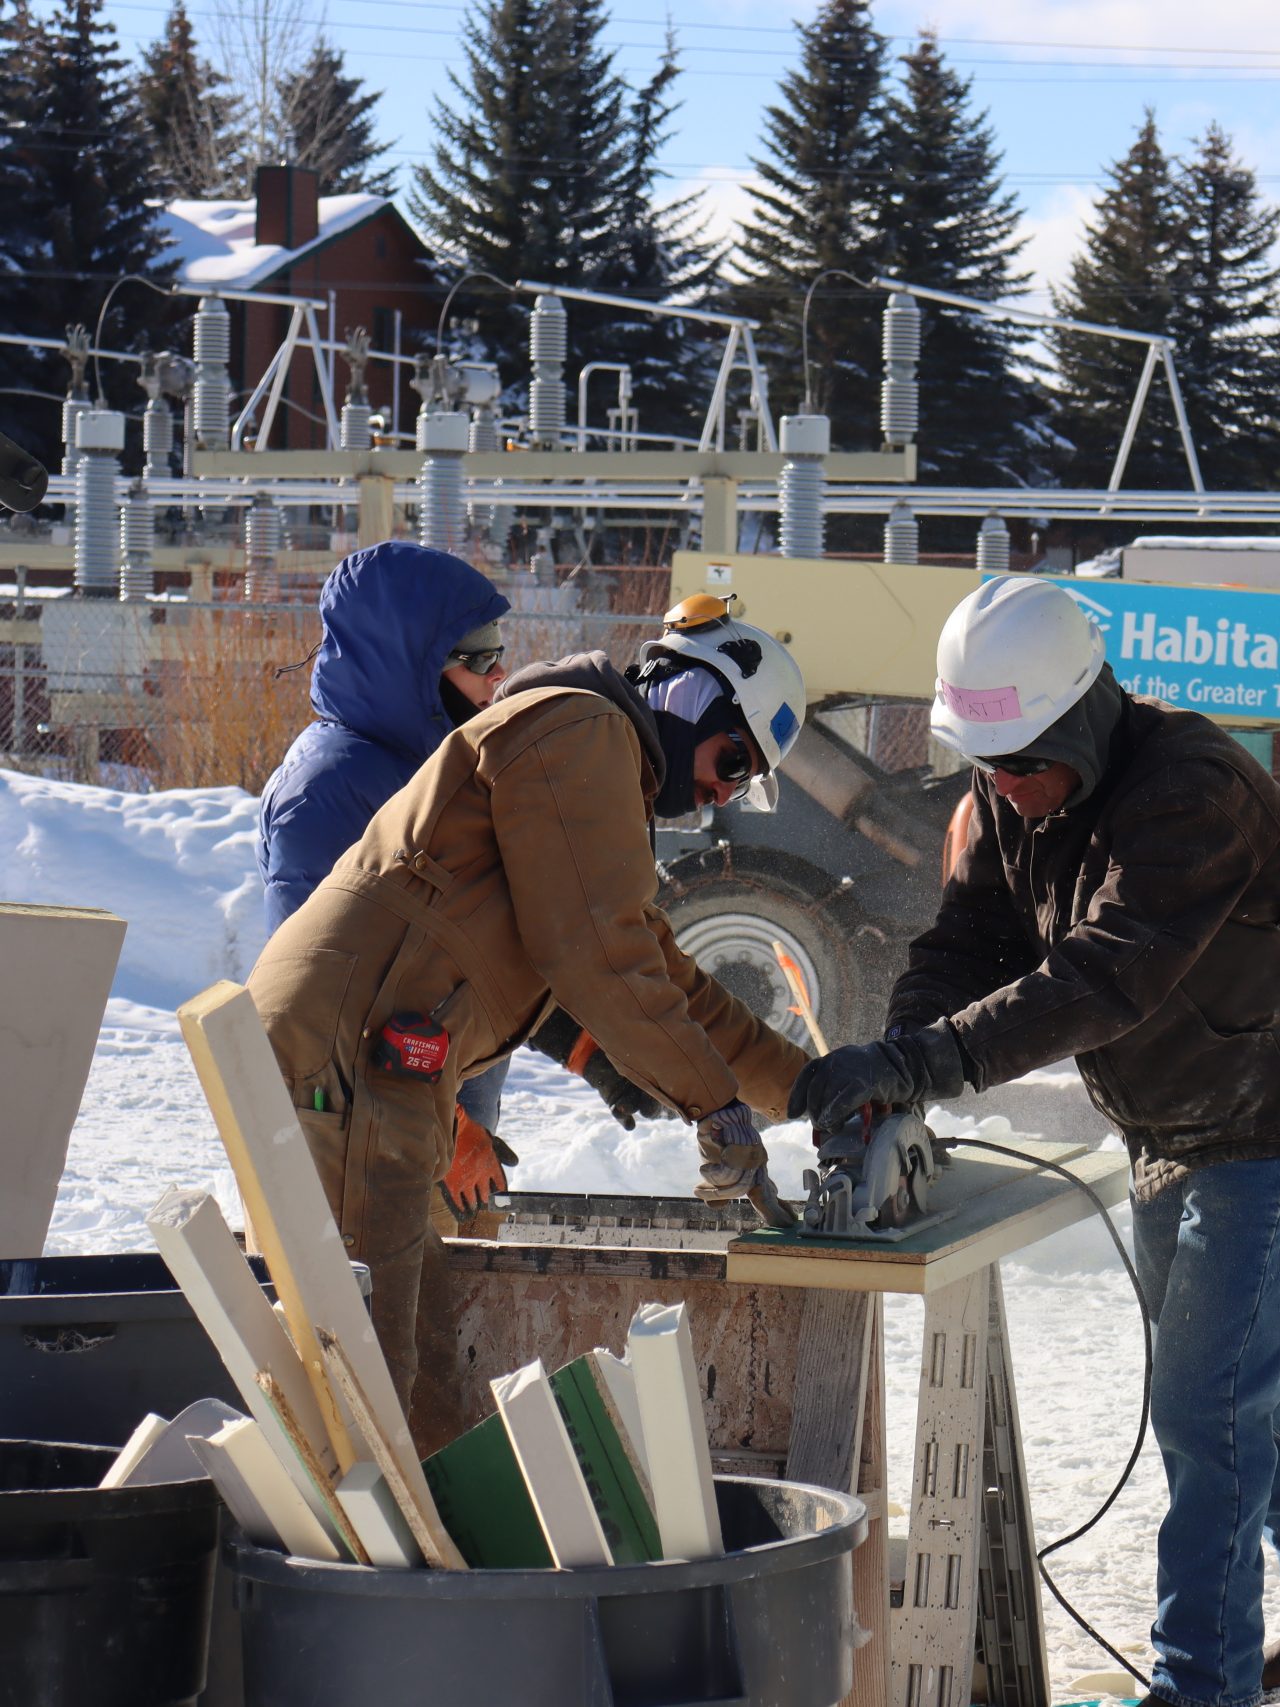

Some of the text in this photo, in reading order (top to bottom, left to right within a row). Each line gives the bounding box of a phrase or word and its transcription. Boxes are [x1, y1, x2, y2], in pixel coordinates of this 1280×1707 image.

[1119, 674, 1142, 694] of
[1147, 675, 1180, 700] the
[1186, 678, 1268, 707] Greater
[403, 1037, 440, 1051] CRAFTSMAN
